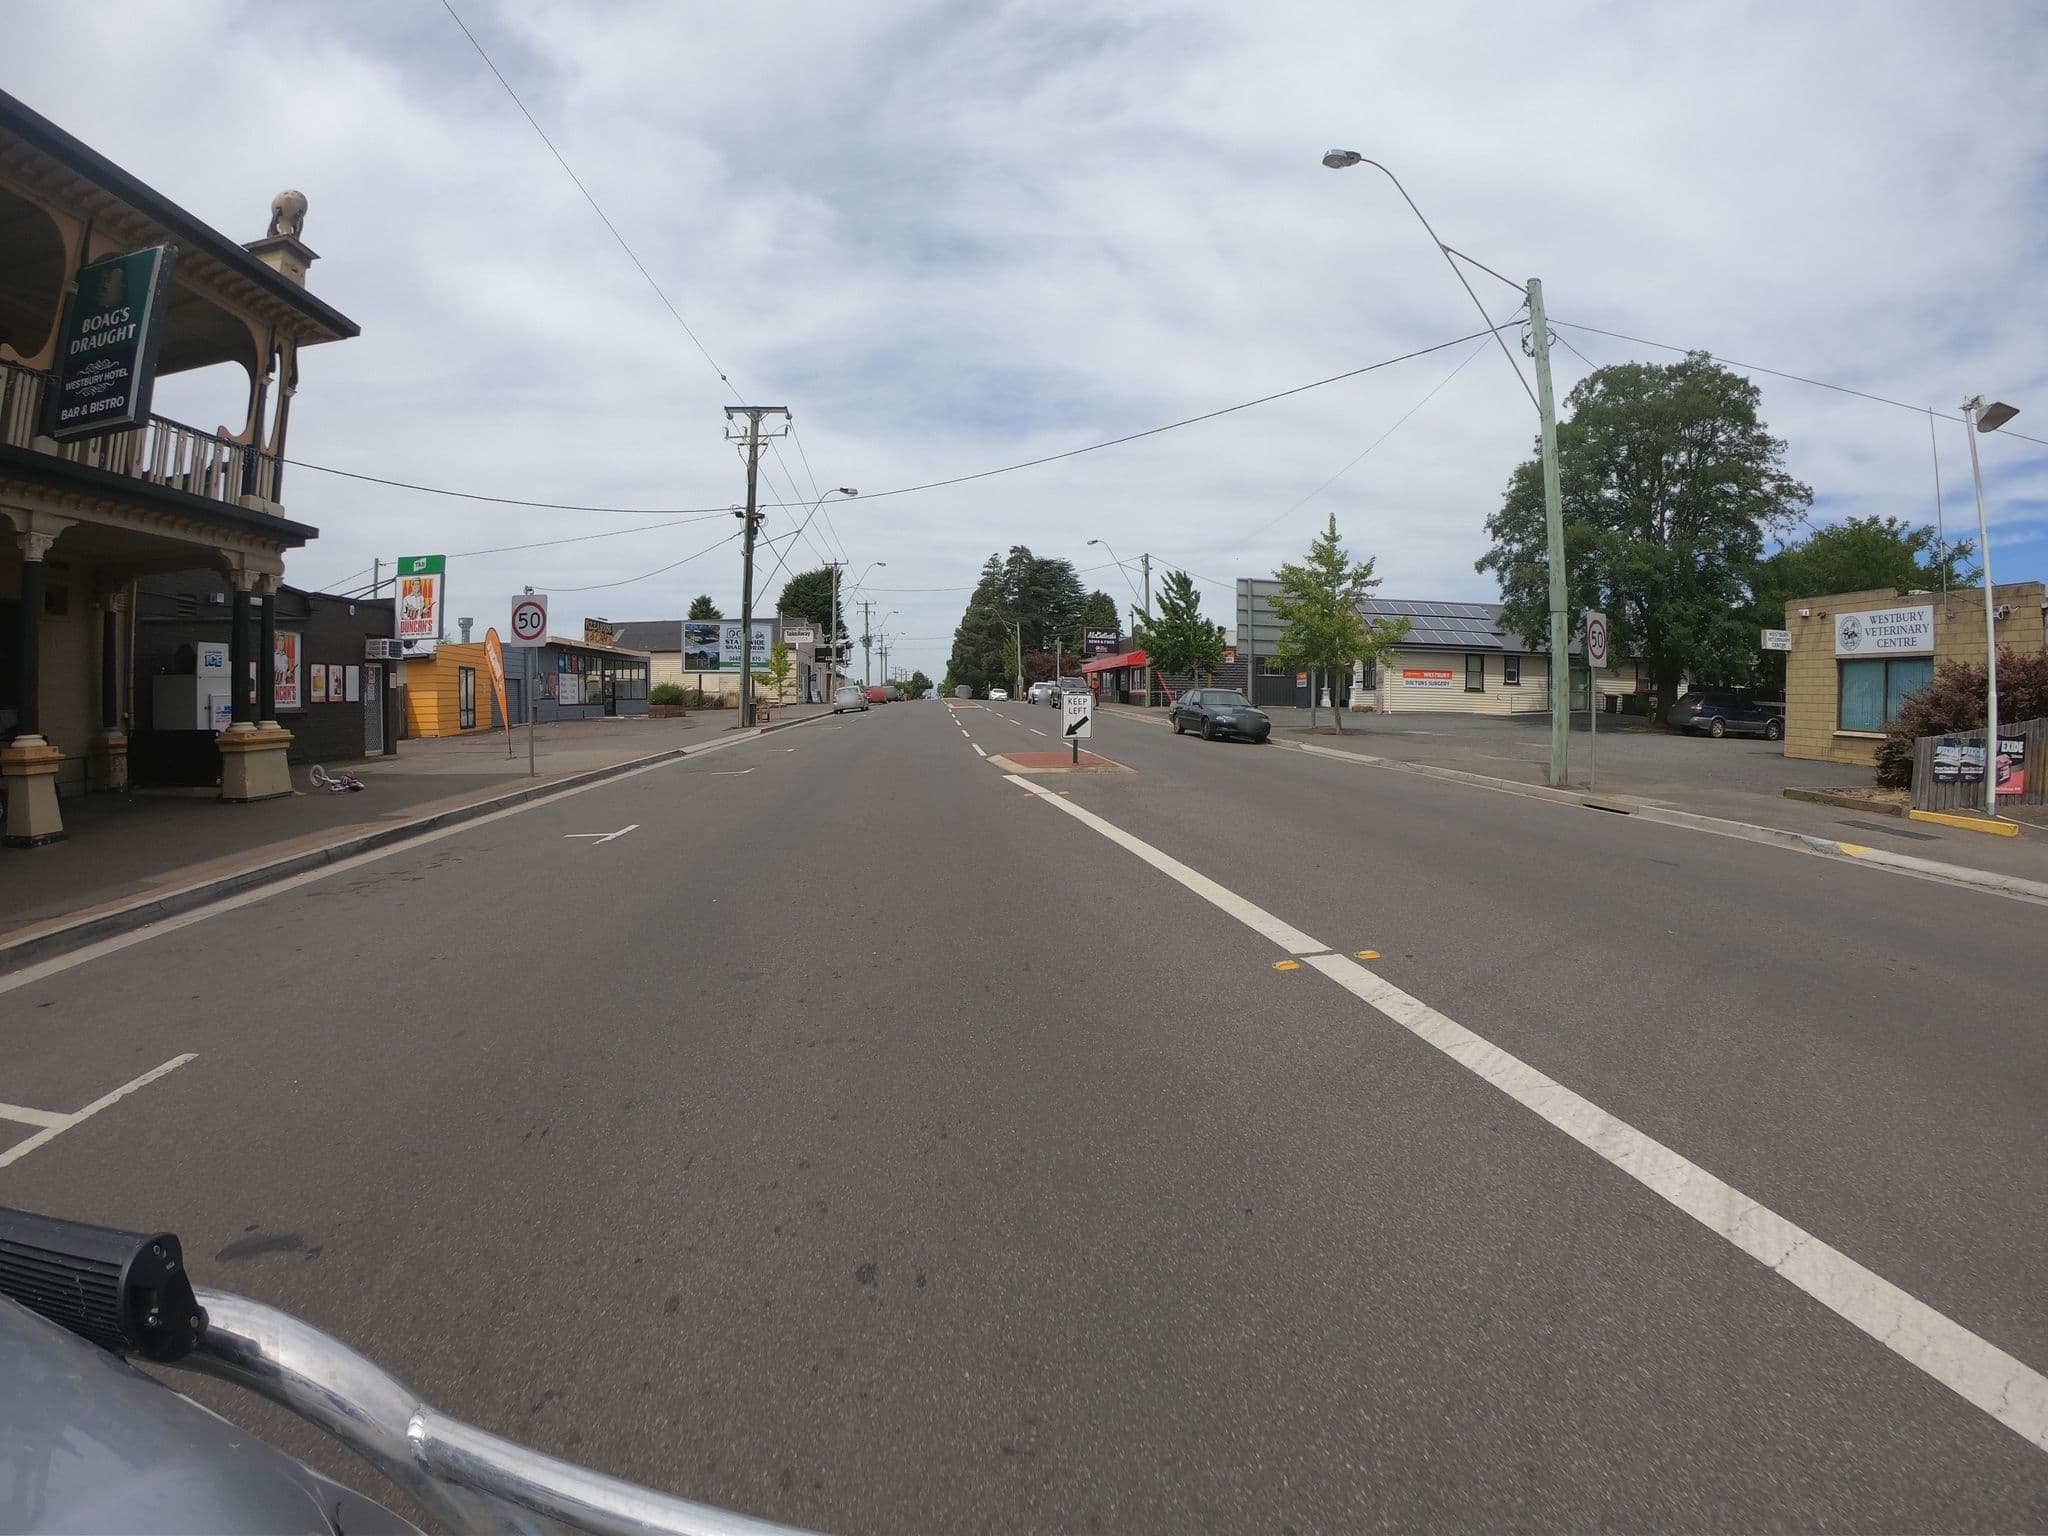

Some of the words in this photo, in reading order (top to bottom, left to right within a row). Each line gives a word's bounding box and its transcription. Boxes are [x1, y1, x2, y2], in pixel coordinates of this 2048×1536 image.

[82, 306, 130, 333] BOAG'S
[70, 323, 136, 355] DRAUGHT
[65, 374, 103, 391] WESTBURY
[104, 368, 128, 382] HOTEL
[61, 406, 80, 420] BAR
[81, 404, 88, 415] &
[89, 396, 125, 413] BISTRO
[518, 612, 540, 629] 50
[1869, 611, 1924, 624] WESTBURY
[1865, 624, 1930, 637] VETERINARY
[1591, 630, 1604, 648] 50
[1876, 637, 1918, 648] CENTRE
[204, 654, 223, 667] ICE
[1067, 697, 1088, 706] KEEP
[1068, 706, 1087, 715] LEFT
[2001, 740, 2024, 753] EXIDE
